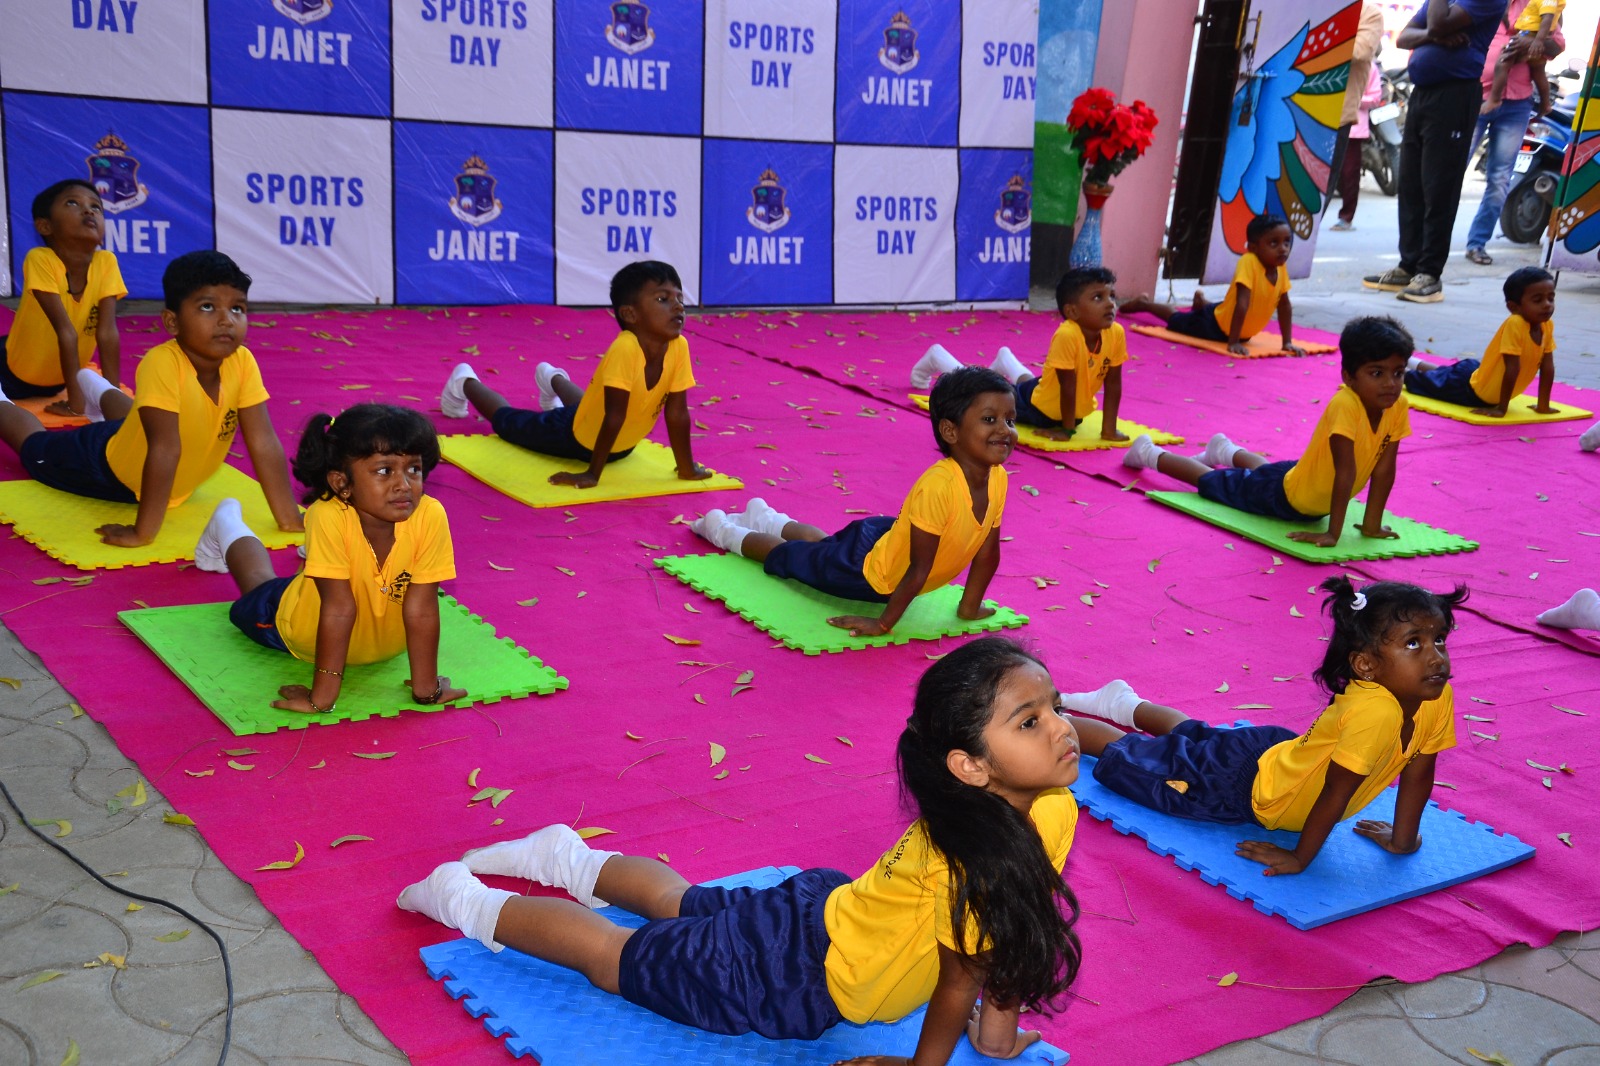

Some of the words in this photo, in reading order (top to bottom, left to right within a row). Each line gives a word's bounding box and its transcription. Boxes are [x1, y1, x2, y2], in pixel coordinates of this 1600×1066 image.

[72, 0, 137, 35] DAY
[421, 0, 527, 30] SPORTS
[248, 25, 352, 67] JANET
[450, 35, 501, 67] DAY
[729, 22, 814, 54] SPORTS
[586, 56, 671, 91] JANET
[751, 60, 792, 88] DAY
[1003, 75, 1037, 100] DAY
[861, 75, 933, 106] JANET
[247, 173, 364, 207] SPORTS
[582, 187, 677, 218] SPORTS
[856, 195, 938, 221] SPORTS
[104, 219, 170, 254] NET
[279, 215, 336, 247] DAY
[428, 230, 520, 262] JANET
[607, 226, 653, 253] DAY
[877, 230, 916, 255] DAY
[729, 236, 804, 264] JANET
